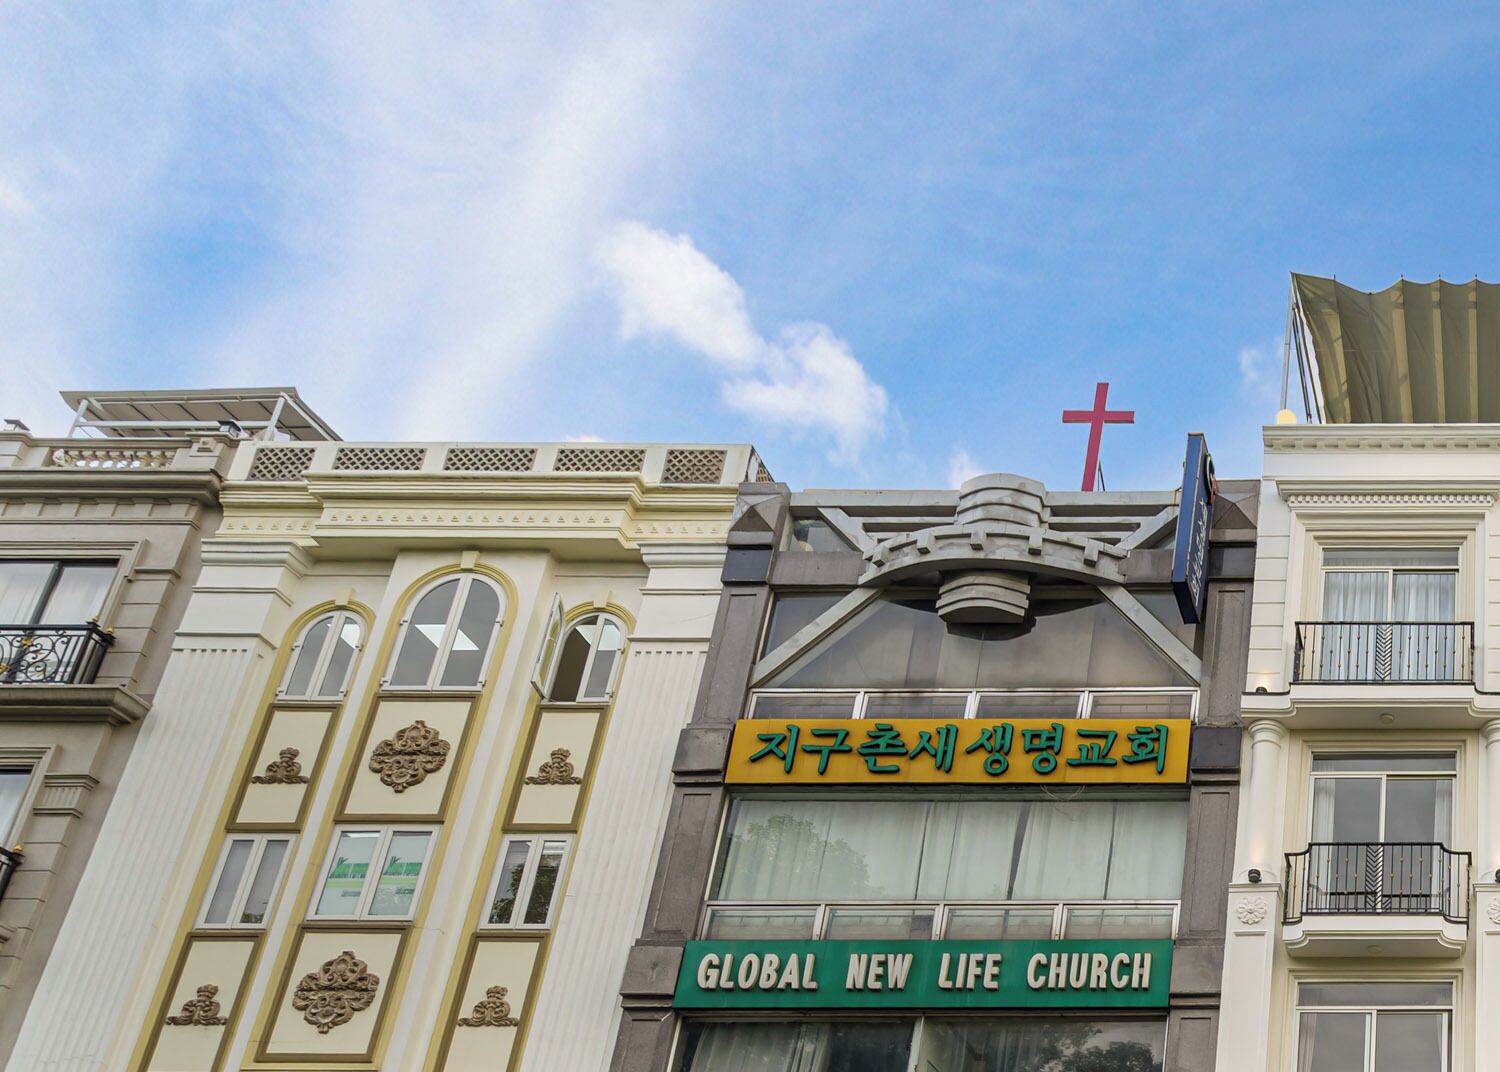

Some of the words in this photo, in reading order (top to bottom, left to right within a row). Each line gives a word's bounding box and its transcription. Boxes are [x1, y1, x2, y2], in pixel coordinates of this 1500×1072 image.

[749, 722, 1168, 776] 지구촌새생명교회
[696, 952, 819, 991] GLOBAL
[845, 953, 914, 991] NEW
[938, 952, 1002, 990] LIFE
[1026, 952, 1152, 990] CHURCH
